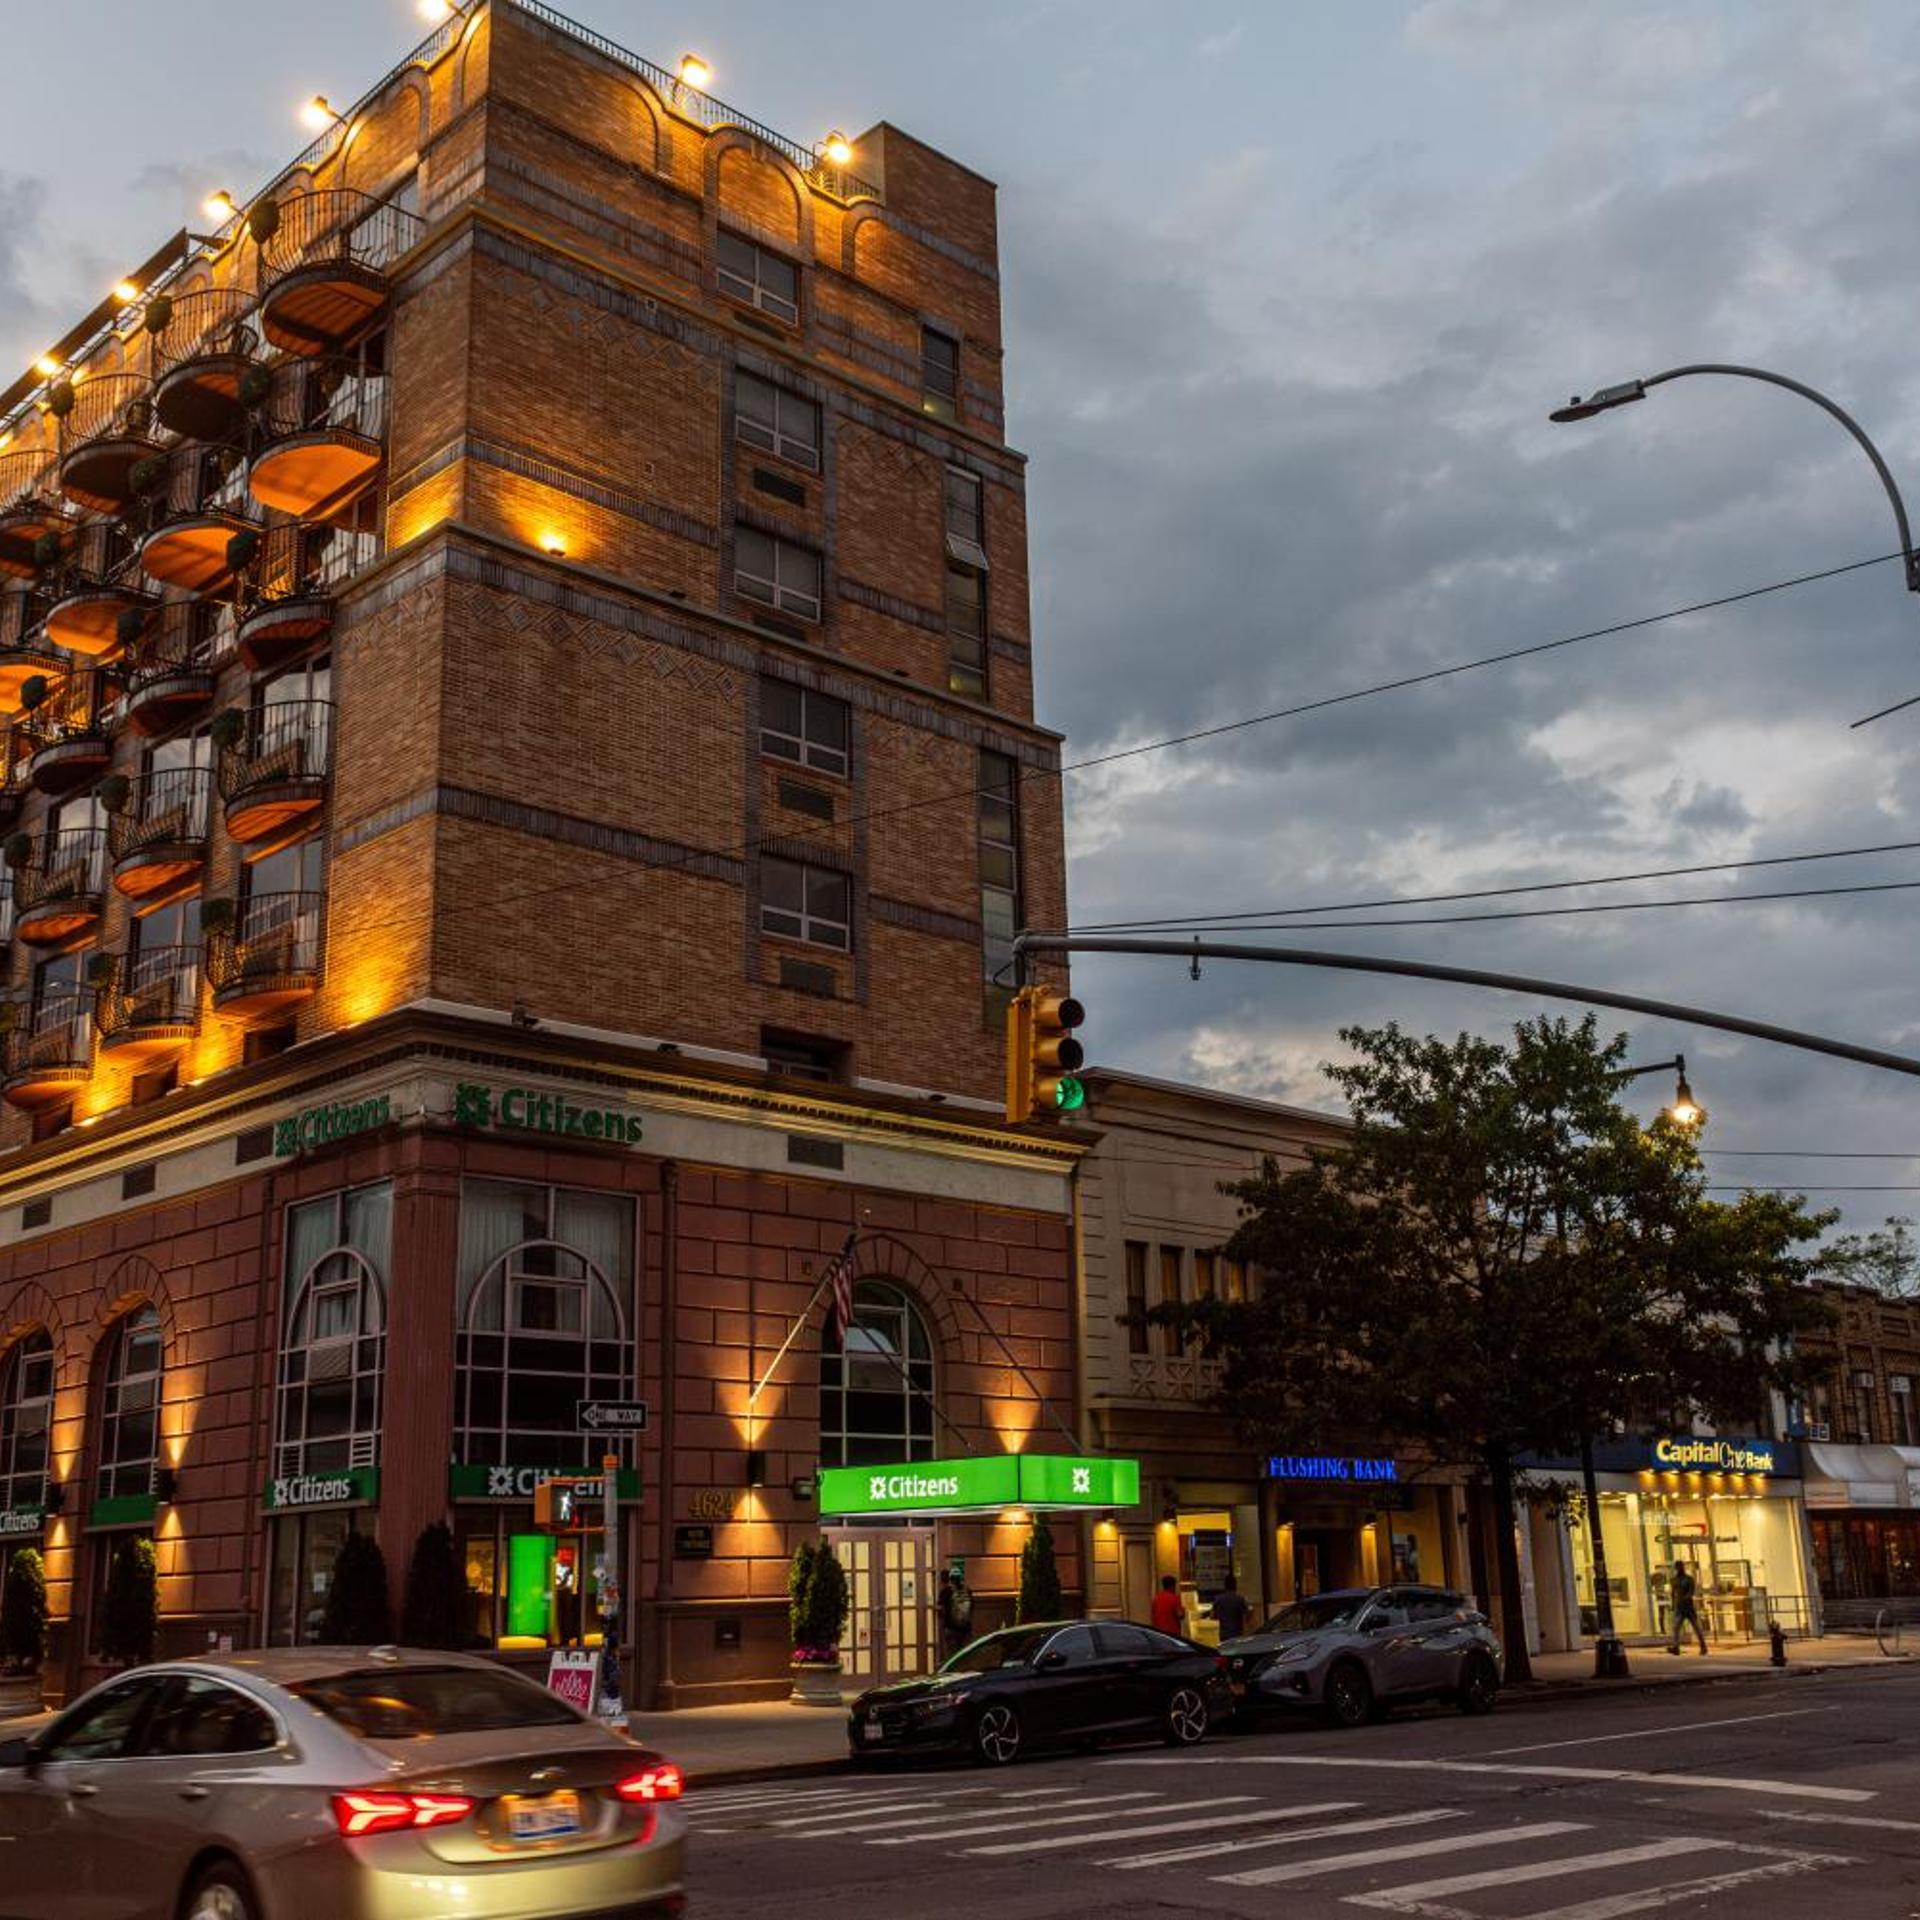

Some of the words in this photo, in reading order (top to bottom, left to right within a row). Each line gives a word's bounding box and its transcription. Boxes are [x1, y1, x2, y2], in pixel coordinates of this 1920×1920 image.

[301, 1094, 389, 1148] Citizens
[502, 1087, 643, 1143] Citizens
[617, 1410, 637, 1421] WAY
[1269, 1457, 1348, 1479] FLUSHING
[1354, 1457, 1397, 1482] BANK
[1746, 1451, 1773, 1471] Bank
[288, 1475, 351, 1504] Citizens
[888, 1474, 958, 1498] Citizens
